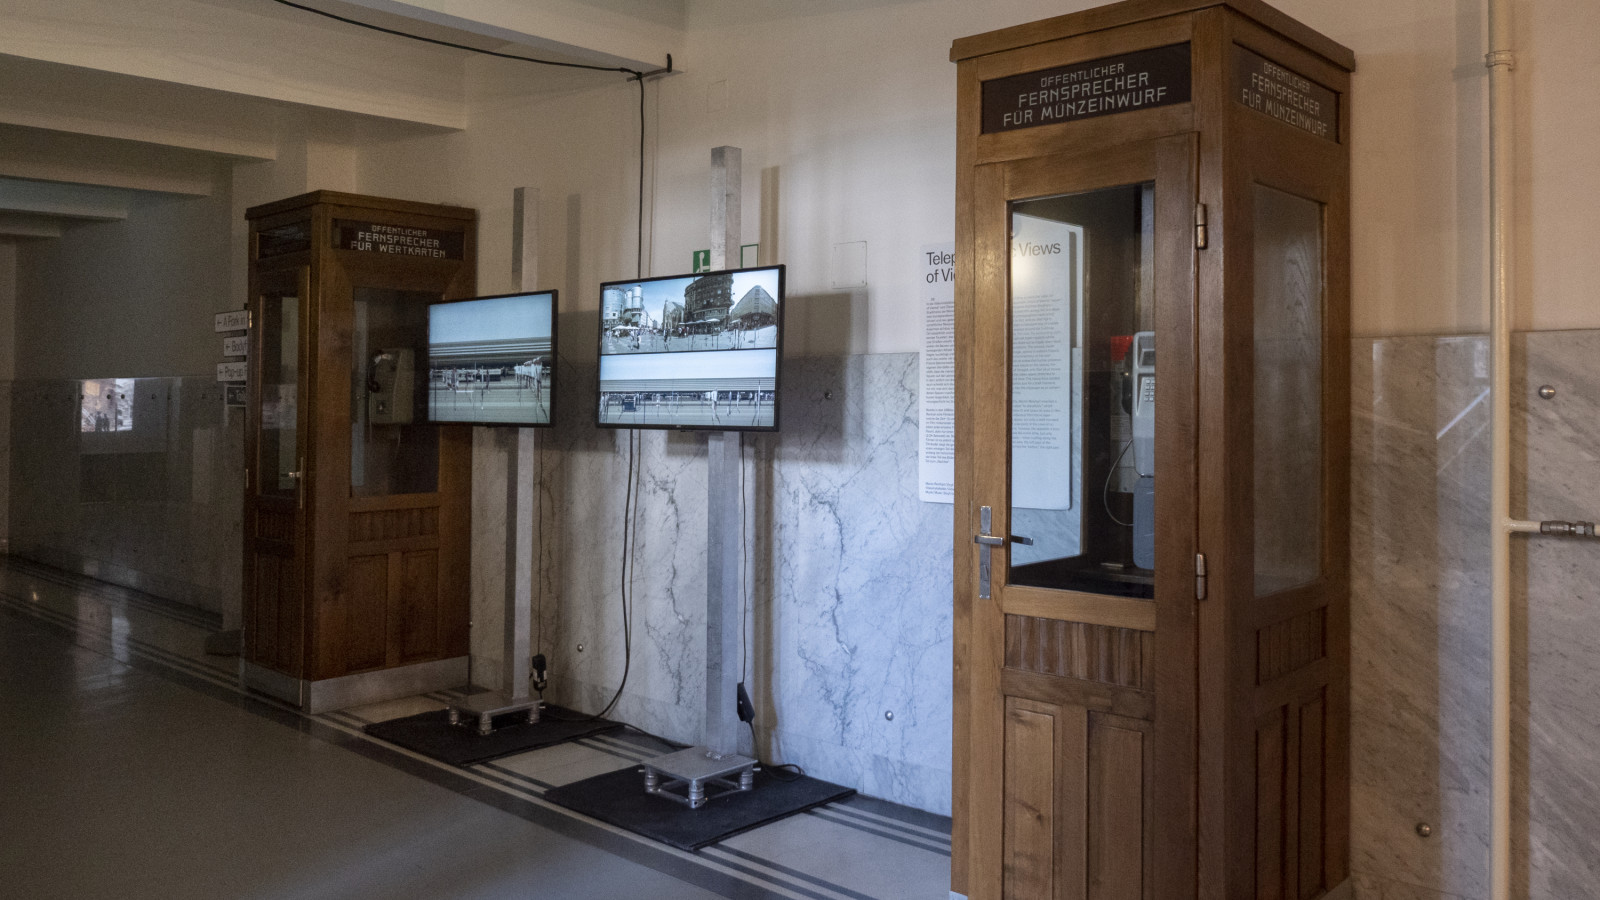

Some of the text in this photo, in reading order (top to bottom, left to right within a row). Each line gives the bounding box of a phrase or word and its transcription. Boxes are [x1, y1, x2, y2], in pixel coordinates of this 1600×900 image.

[1018, 72, 1149, 108] FERNSPRECHER
[1252, 73, 1320, 116] FERNSPRECHER
[1003, 86, 1167, 127] FÜR MÜNZEINWURF
[358, 231, 440, 248] FERNSPRECHER
[379, 244, 446, 259] WERTKARTEN
[1018, 241, 1062, 257] Views
[926, 267, 956, 283] of Vi
